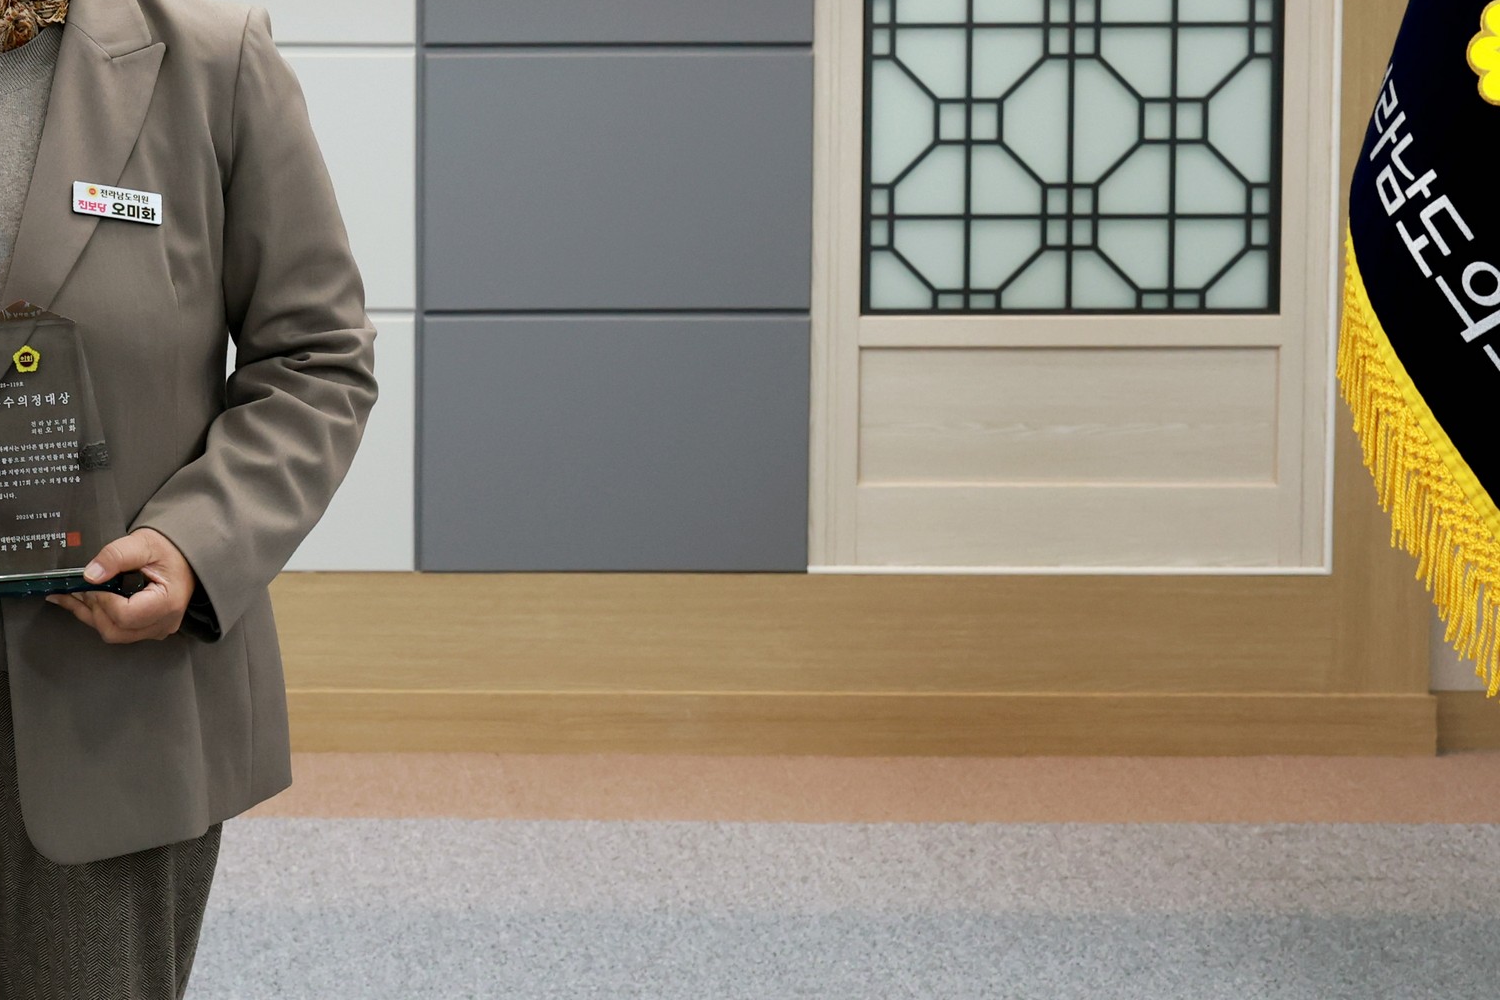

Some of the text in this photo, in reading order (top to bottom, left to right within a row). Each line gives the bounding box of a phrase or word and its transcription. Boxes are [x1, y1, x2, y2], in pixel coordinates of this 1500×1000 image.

[99, 188, 149, 205] 전라남도의원
[78, 199, 156, 221] 진보당 오미화
[44, 424, 77, 435] 오미화
